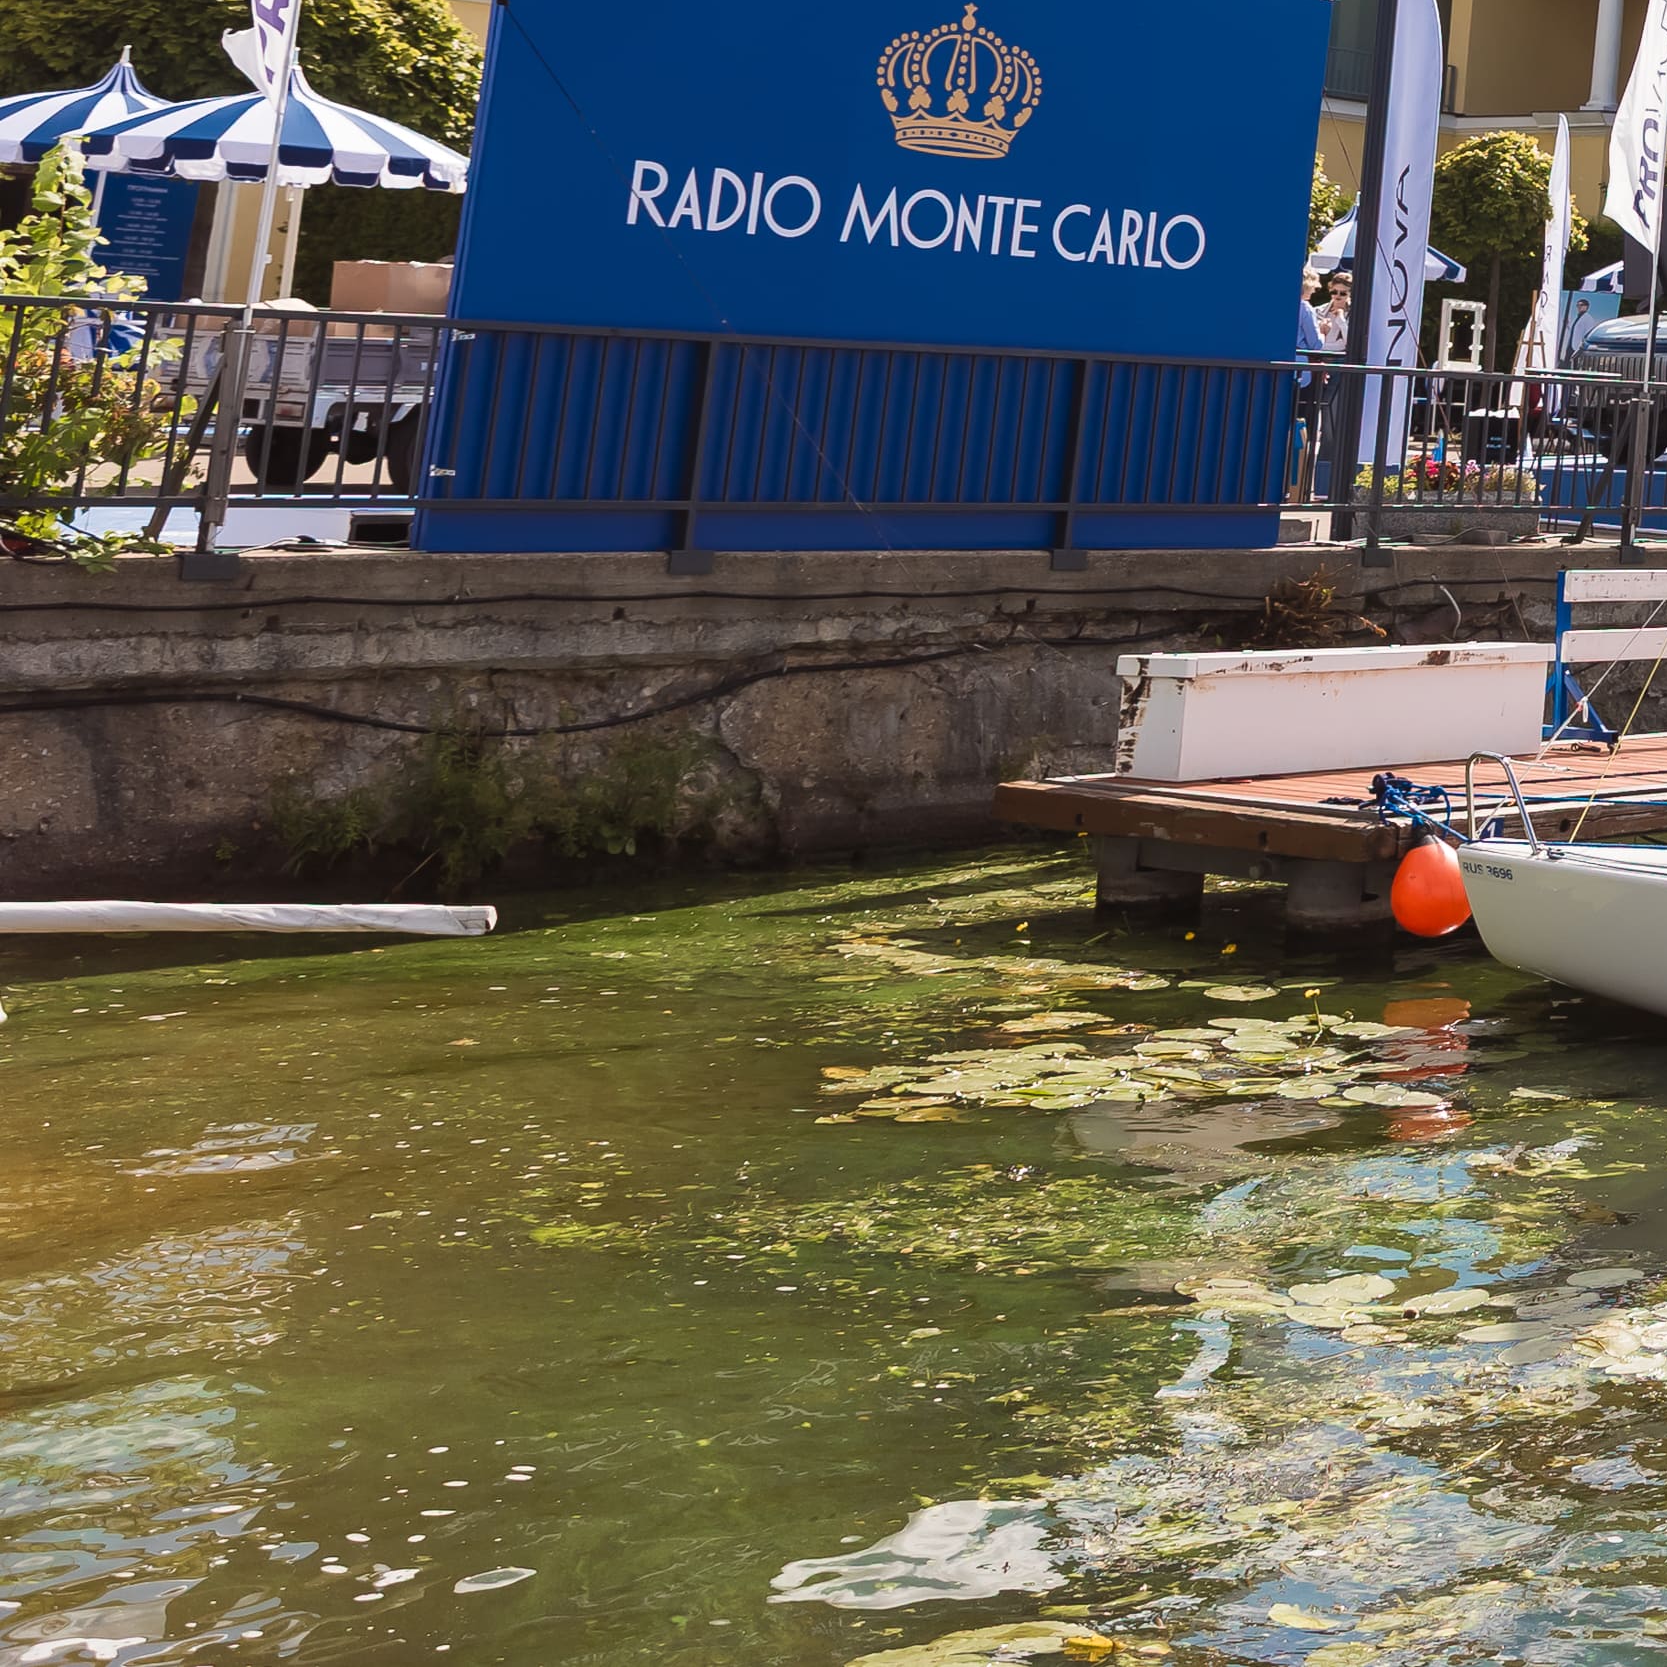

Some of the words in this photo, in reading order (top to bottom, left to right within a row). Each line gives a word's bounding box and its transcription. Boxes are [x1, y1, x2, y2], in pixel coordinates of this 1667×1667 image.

[626, 159, 821, 238] RADIO
[839, 181, 1042, 258] MONTE
[1052, 203, 1206, 270] CARLO
[1386, 163, 1410, 367] NOVA
[1462, 861, 1484, 875] RUS
